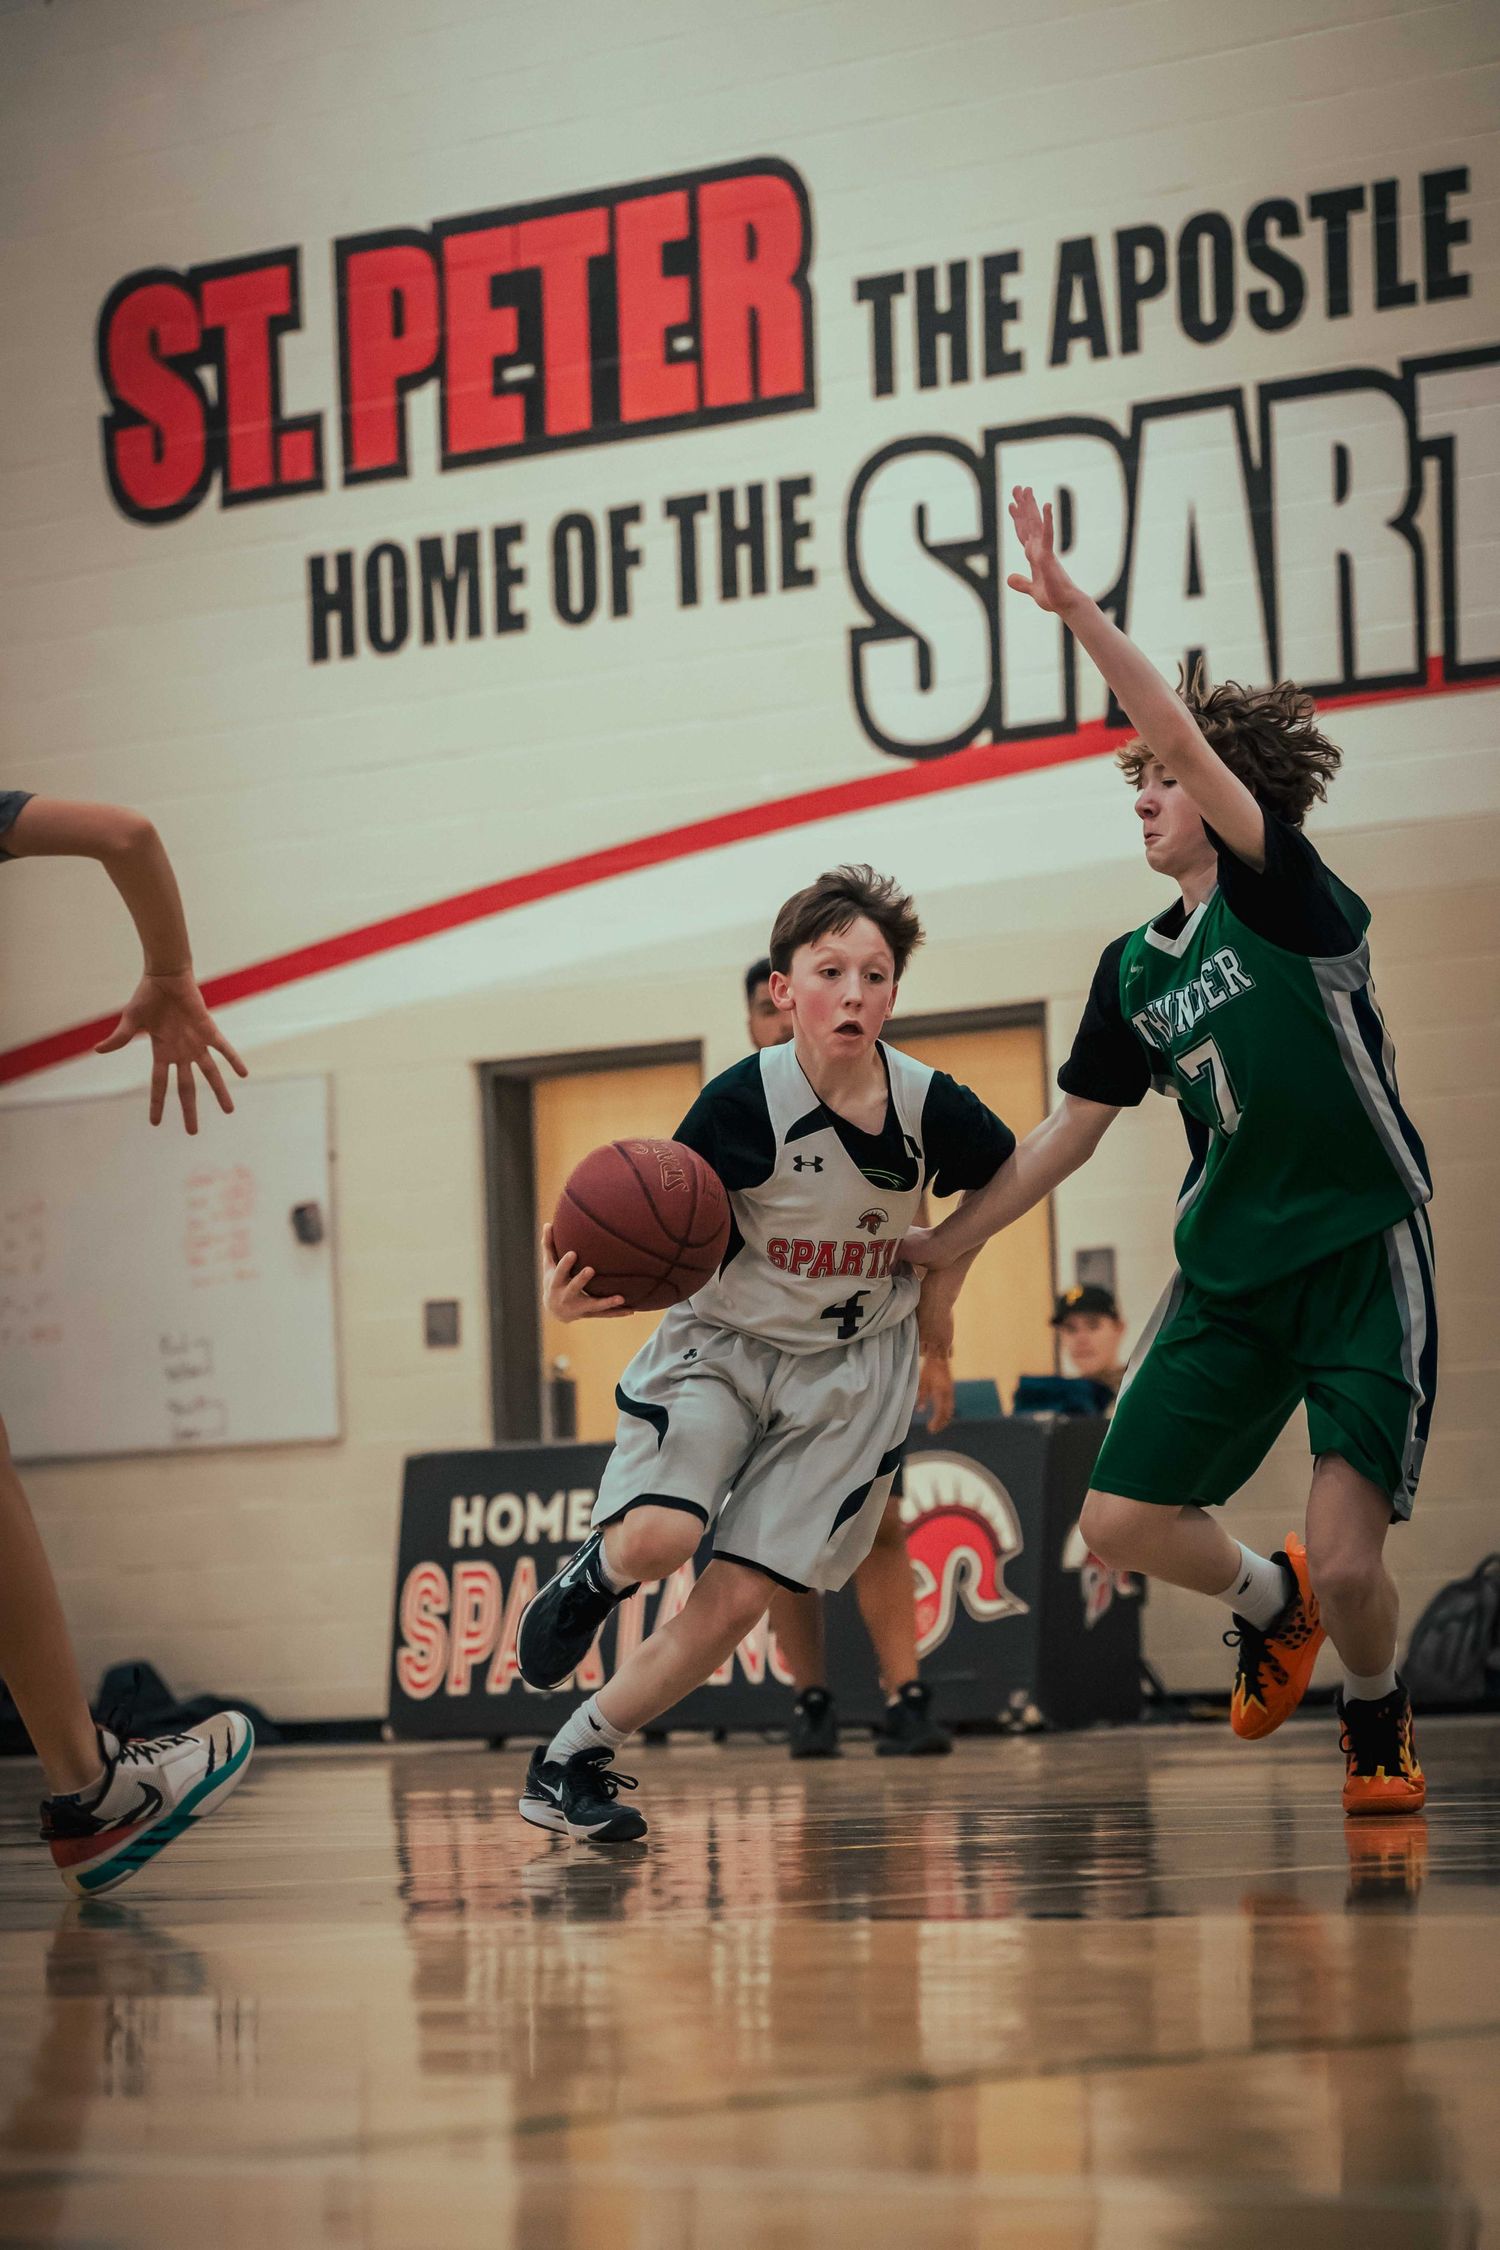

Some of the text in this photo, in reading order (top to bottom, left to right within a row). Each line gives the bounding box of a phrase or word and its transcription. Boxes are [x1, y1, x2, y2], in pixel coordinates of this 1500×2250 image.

[95, 156, 1471, 528] ST. PETER THE APOSTLE
[308, 523, 527, 665] HOME
[552, 503, 643, 626] OF
[664, 474, 816, 608] THE
[1174, 1032, 1245, 1139] 7
[820, 1290, 871, 1339] 4
[449, 1488, 597, 1548] HOME
